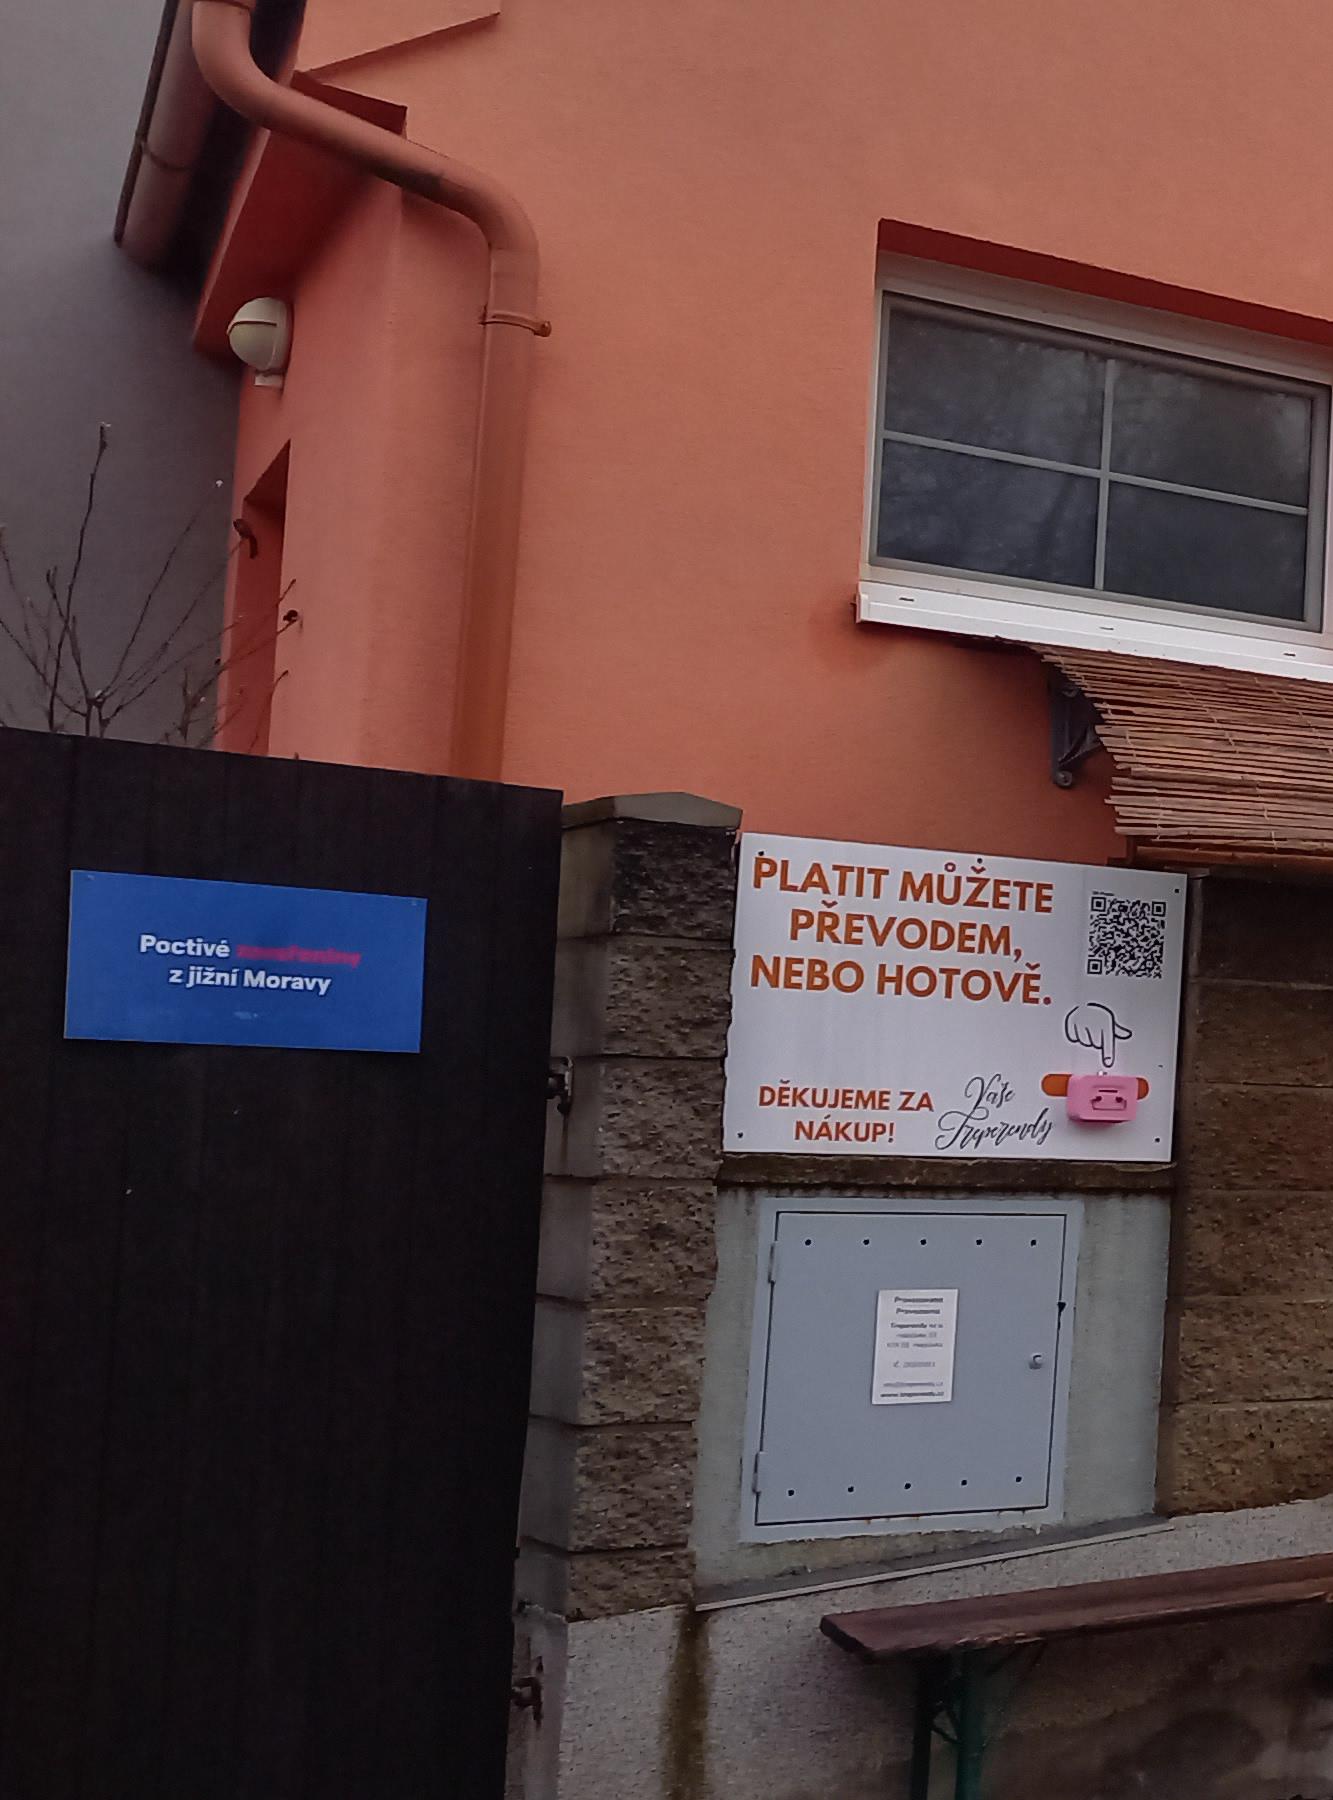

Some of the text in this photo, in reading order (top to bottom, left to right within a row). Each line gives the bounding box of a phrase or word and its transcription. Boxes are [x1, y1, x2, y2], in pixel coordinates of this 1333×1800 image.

[754, 857, 1053, 912] PLATIT MŮŽETE
[141, 935, 229, 957] Poctivé
[790, 900, 1023, 963] PŘEVODEM,
[170, 966, 331, 994] z jižní Moravy
[751, 955, 1051, 1004] NEBO HOTOVĚ.
[759, 1079, 935, 1112] DĚKUJEME ZA
[965, 1073, 1016, 1109] Vaše
[795, 1114, 895, 1142] NÁKUP!
[935, 1107, 1053, 1150] Treperendy
